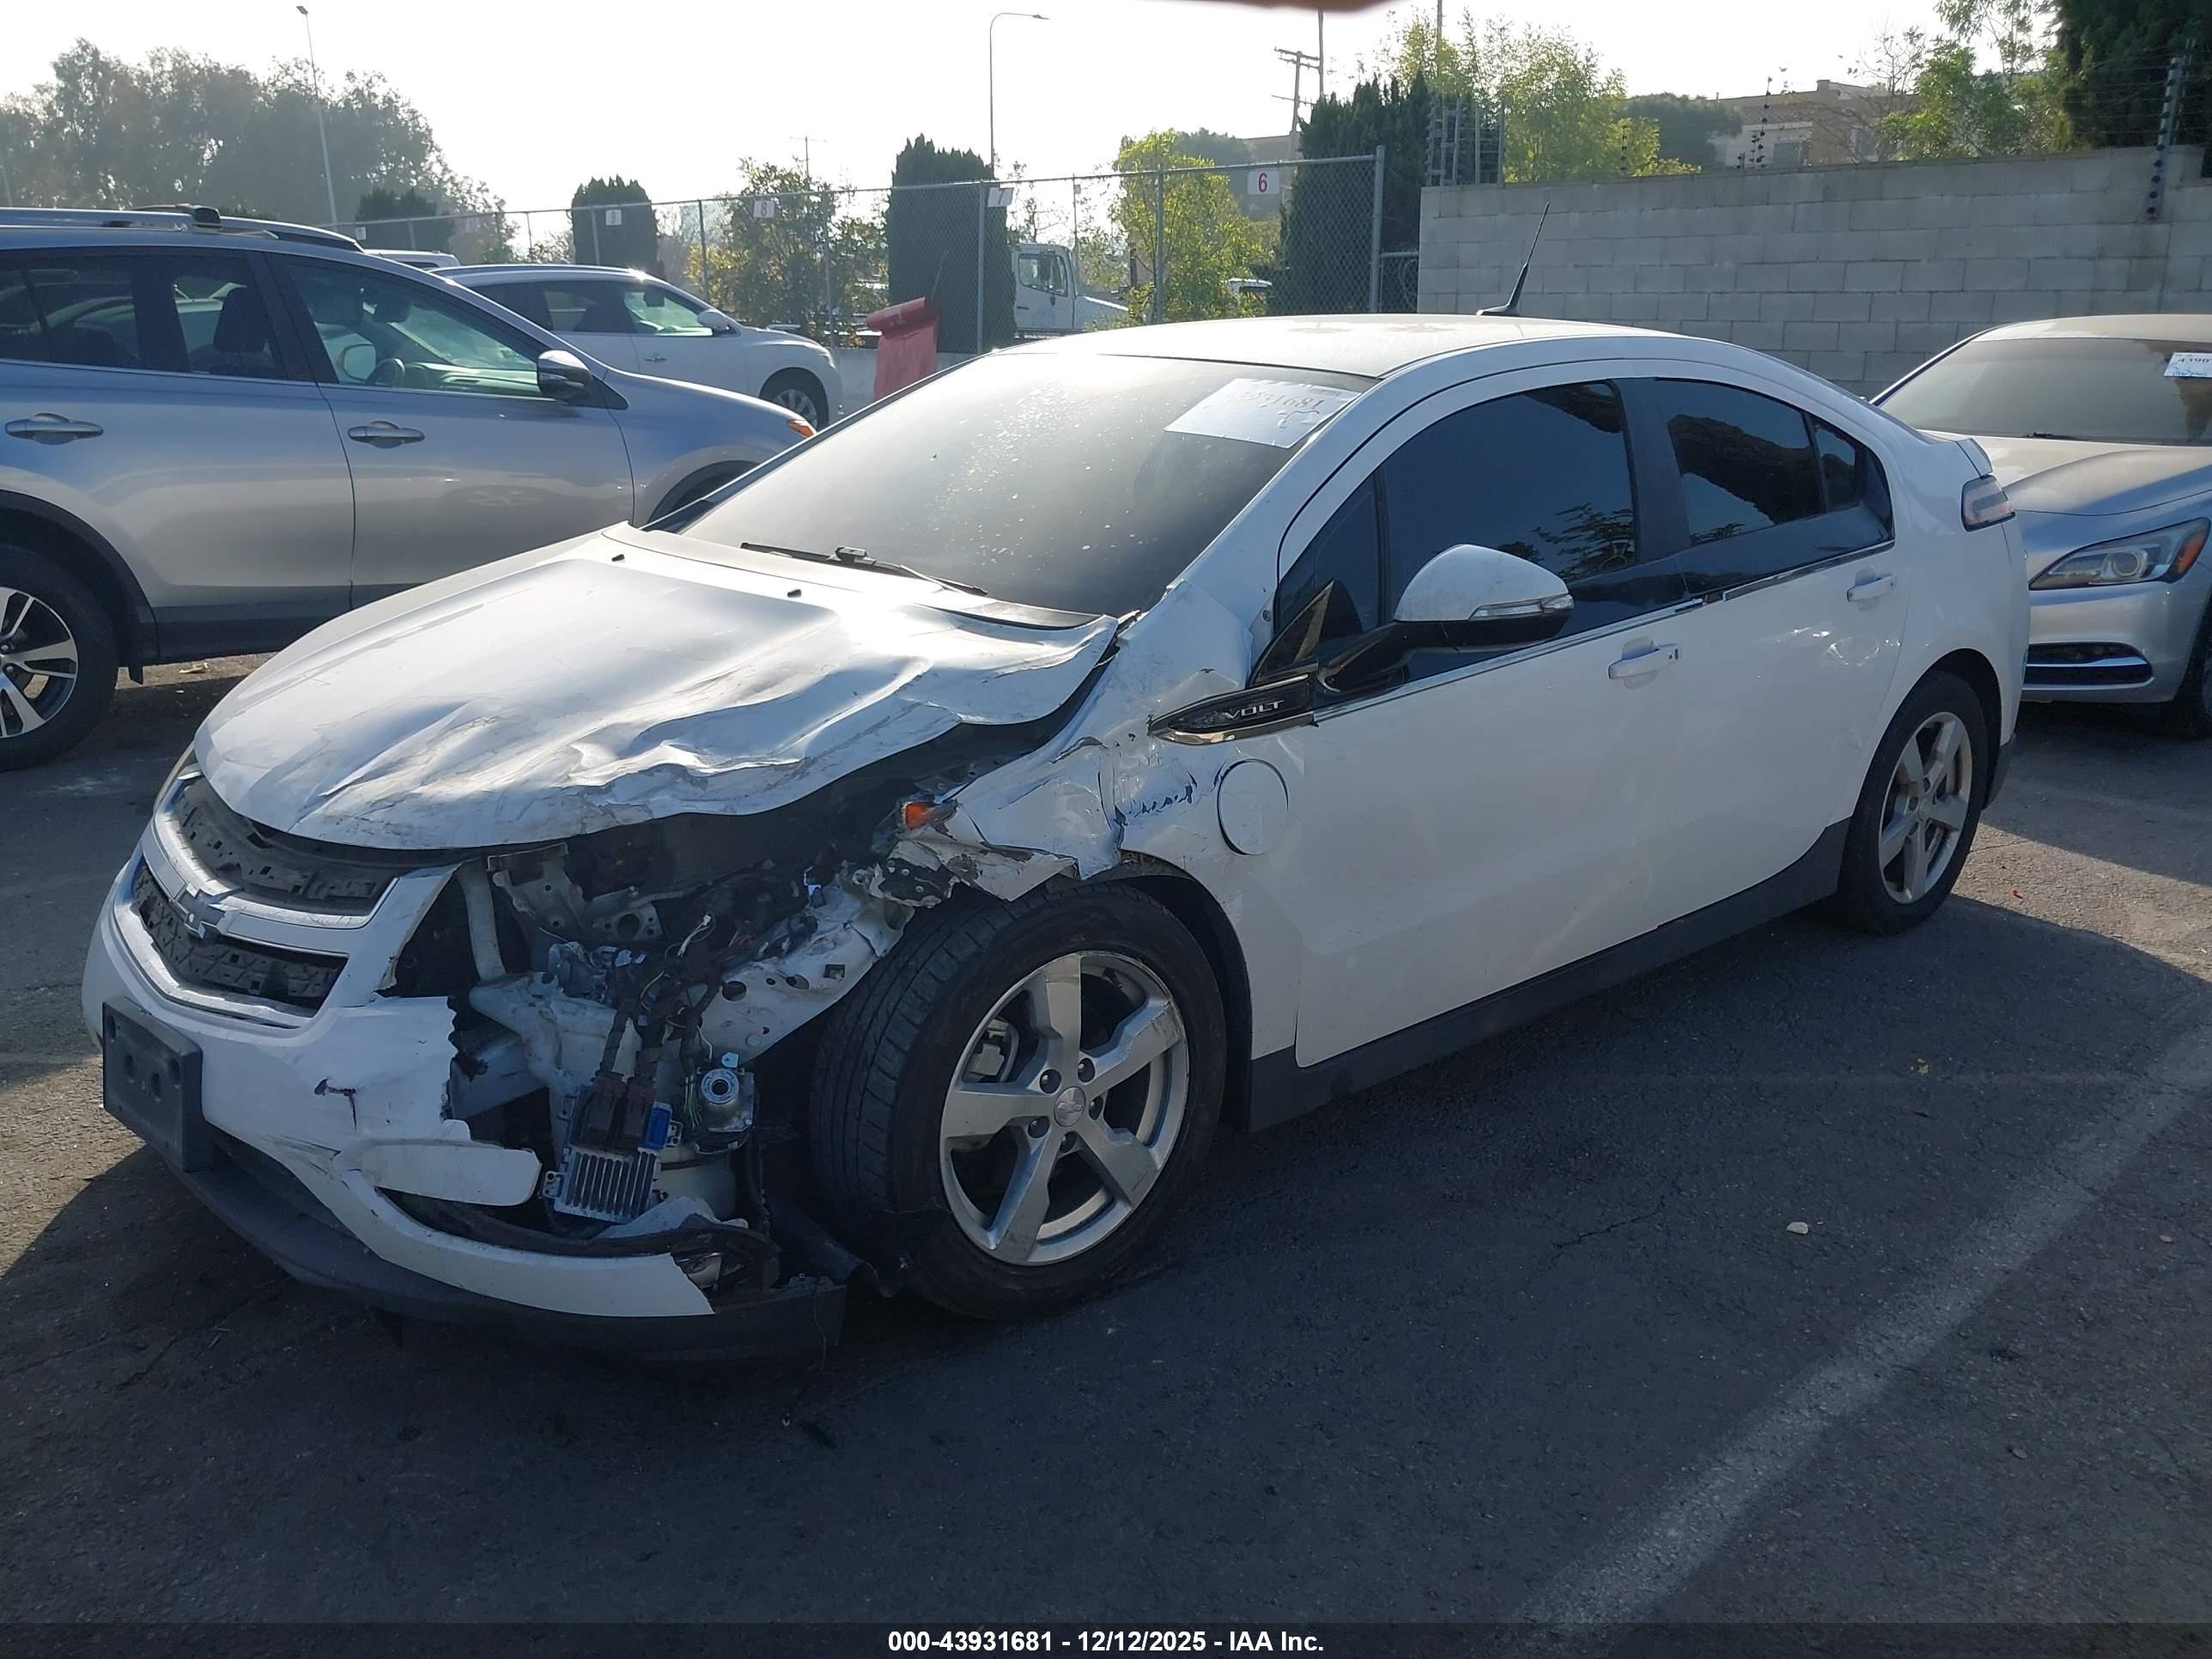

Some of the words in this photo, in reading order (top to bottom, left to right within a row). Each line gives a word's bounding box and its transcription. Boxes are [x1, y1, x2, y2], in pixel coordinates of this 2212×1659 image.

[1258, 172, 1267, 193] 6
[997, 188, 1006, 205] 7
[760, 201, 768, 216] 8
[1223, 701, 1285, 719] VOLT
